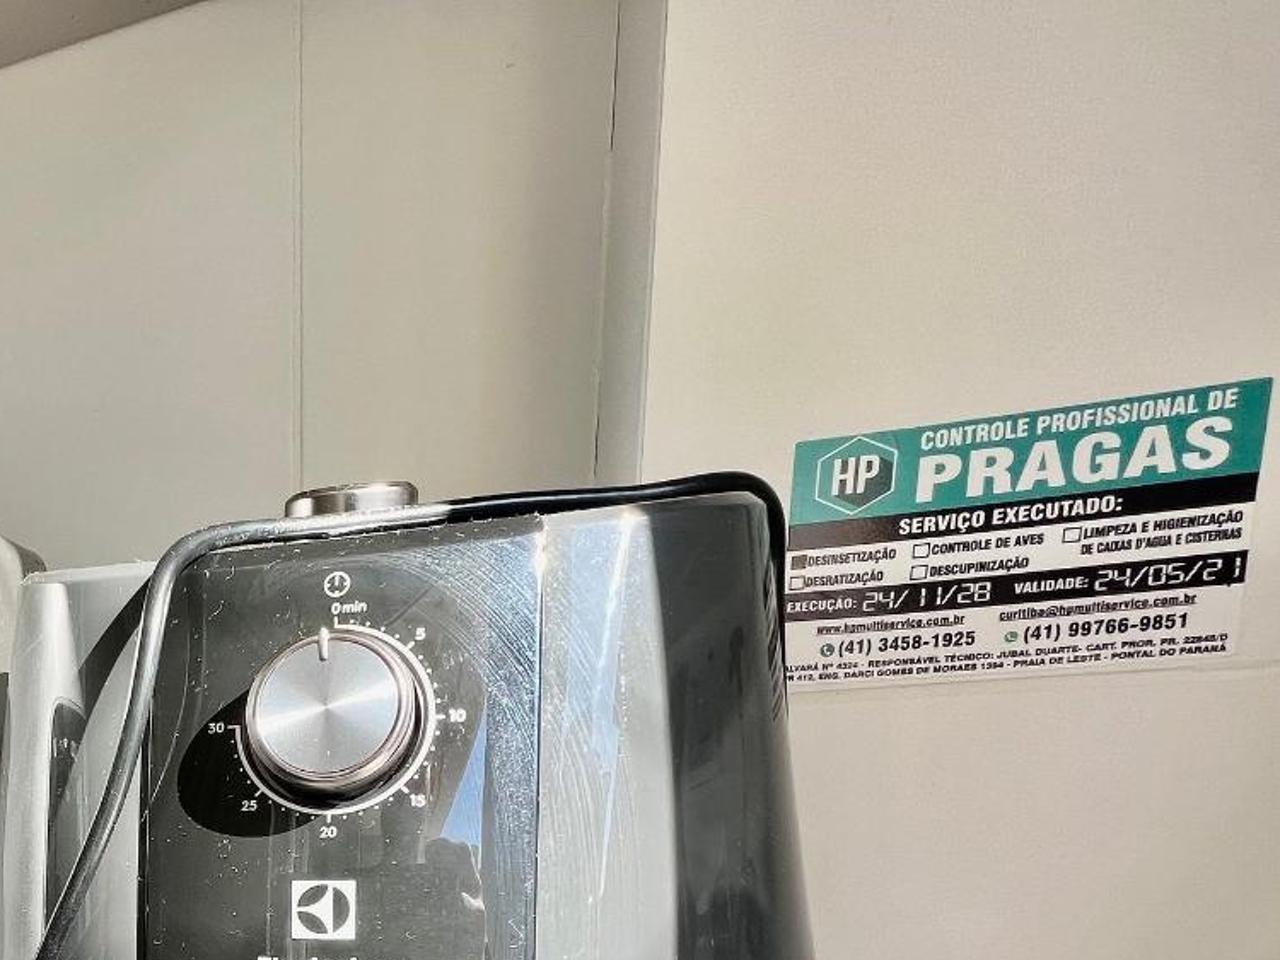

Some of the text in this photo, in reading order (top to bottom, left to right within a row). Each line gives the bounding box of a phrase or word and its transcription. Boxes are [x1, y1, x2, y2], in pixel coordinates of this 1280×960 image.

[920, 387, 1239, 451] CONTROLE PROFISSIONAL DE
[916, 416, 1233, 504] PRAGAS
[831, 454, 880, 496] HP
[898, 495, 1124, 535] SERVIÇO EXECUTADO:
[1083, 510, 1243, 539] LIMPEZA E HIGIENIZAÇÃO
[931, 533, 1044, 556] CONTROLE DE AVES
[1081, 543, 1094, 555] DE
[1097, 539, 1132, 552] CAIXAS
[1175, 534, 1182, 545] E
[1185, 527, 1243, 544] CISTERNAS
[808, 548, 897, 568] DESINSETIZAÇÃO
[929, 557, 1030, 577] DESCUPINIZAÇÃO
[805, 571, 884, 587] DESRATIZAÇÃO
[1014, 577, 1089, 595] VALIDADE:
[786, 598, 858, 613] EXECUÇÃO:
[415, 627, 426, 640] 5
[1023, 612, 1188, 644] (41) 99766-9851
[838, 630, 976, 658] (41) 3458-1925
[916, 666, 930, 675] DE
[1049, 656, 1064, 665] DE
[1160, 647, 1176, 656] DO
[943, 652, 994, 664] TÉCNICO:
[449, 708, 467, 723] 10
[208, 722, 225, 734] 30
[241, 800, 257, 812] 25
[410, 795, 426, 808] 15
[320, 827, 338, 839] 20
